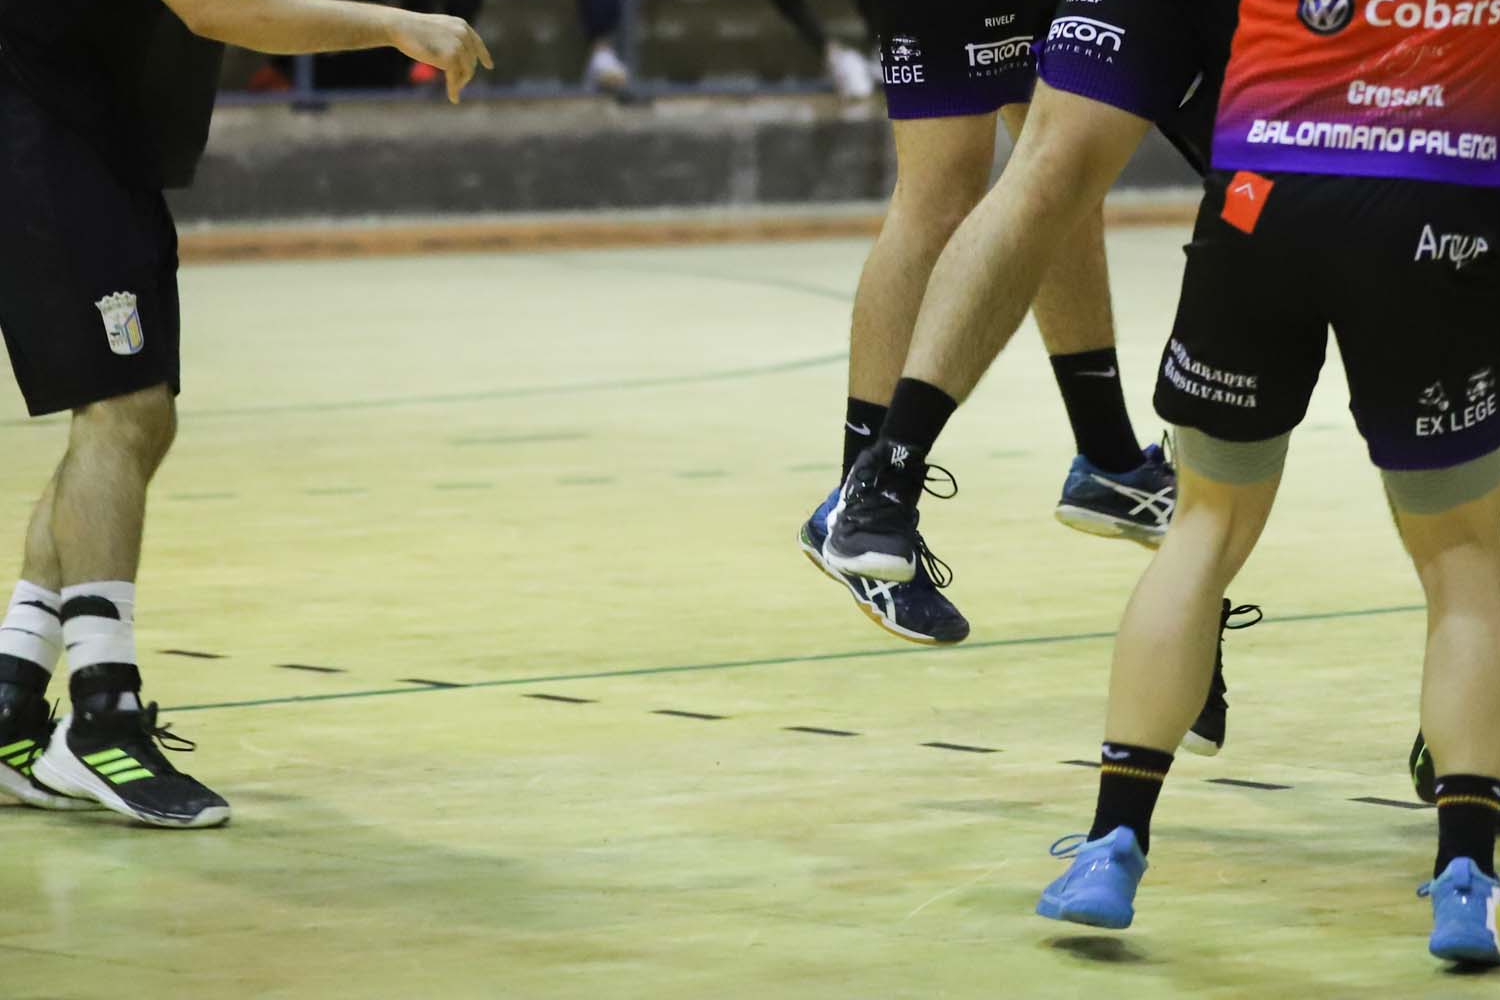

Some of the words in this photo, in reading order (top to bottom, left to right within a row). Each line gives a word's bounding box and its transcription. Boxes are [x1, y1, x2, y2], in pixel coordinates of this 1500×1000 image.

[984, 13, 1016, 28] RIVELF
[1416, 415, 1444, 437] EX
[1450, 392, 1497, 432] LEGE
